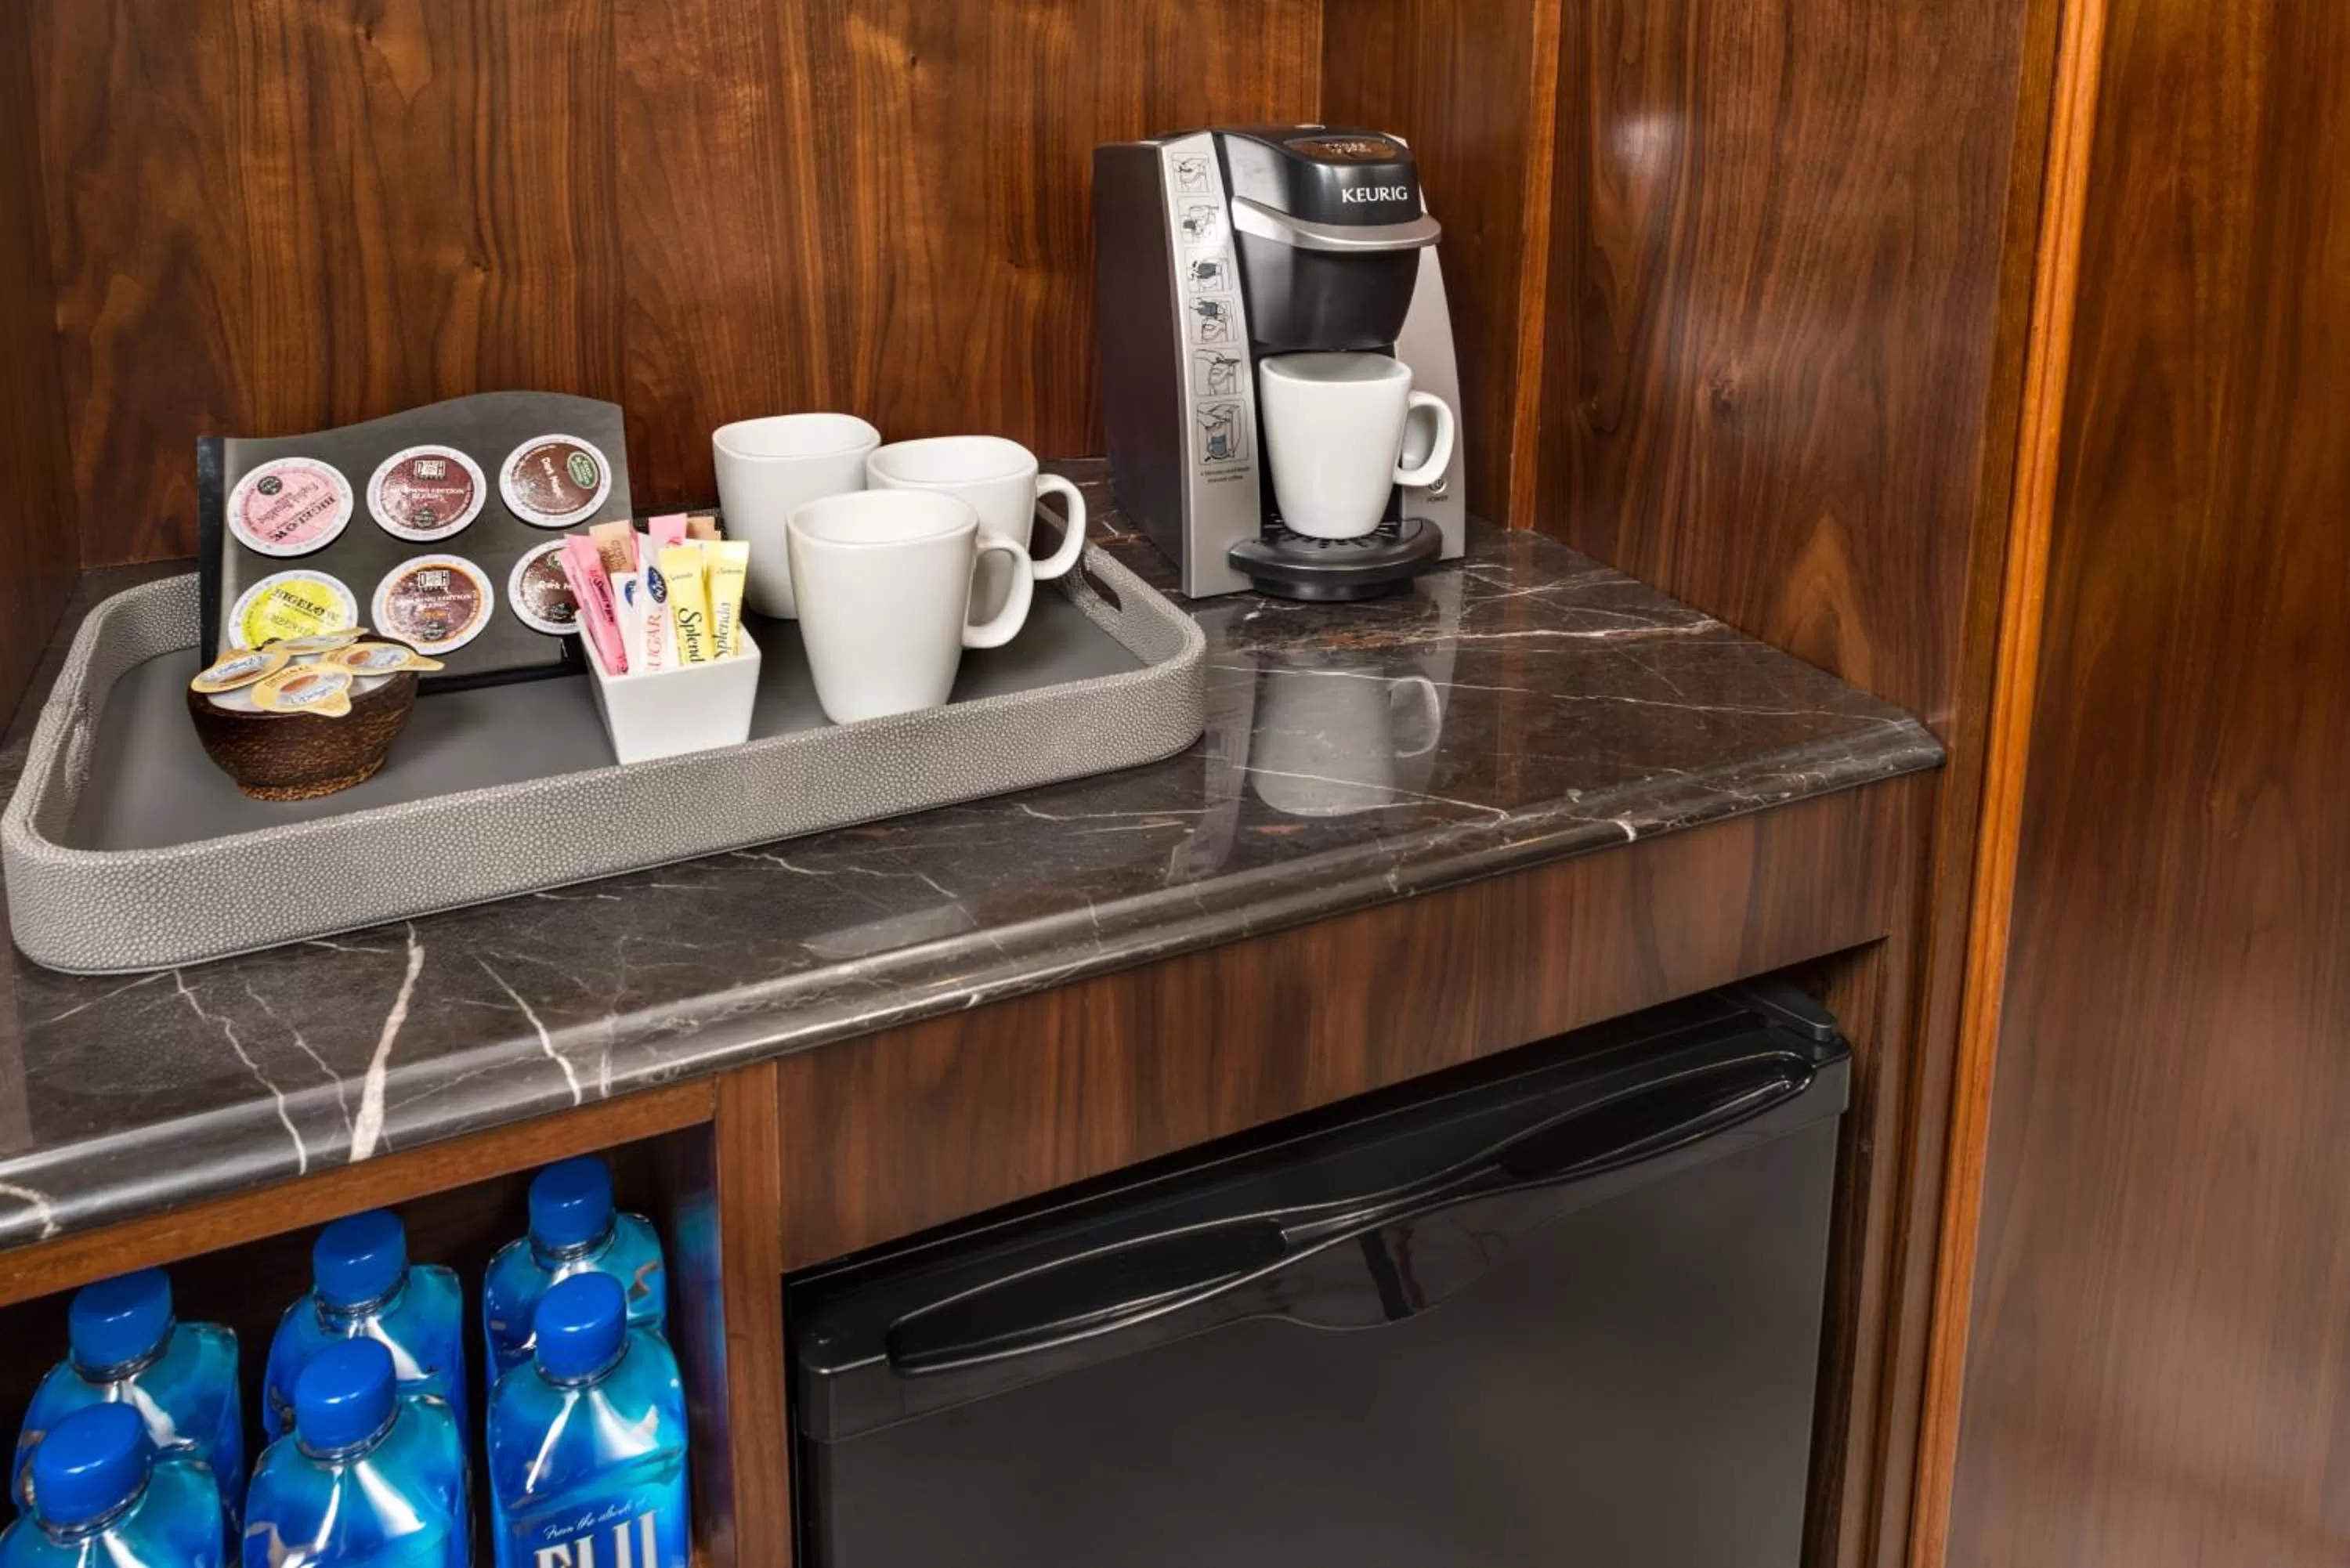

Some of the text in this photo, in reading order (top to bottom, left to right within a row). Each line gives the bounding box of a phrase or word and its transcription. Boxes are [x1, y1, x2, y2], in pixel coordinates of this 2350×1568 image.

[1340, 186, 1408, 204] KEURIG
[271, 493, 336, 542] BIGELOW
[274, 588, 340, 622] BIGELOW
[678, 607, 707, 663] Splend
[543, 1523, 575, 1541] From
[577, 1511, 596, 1530] the
